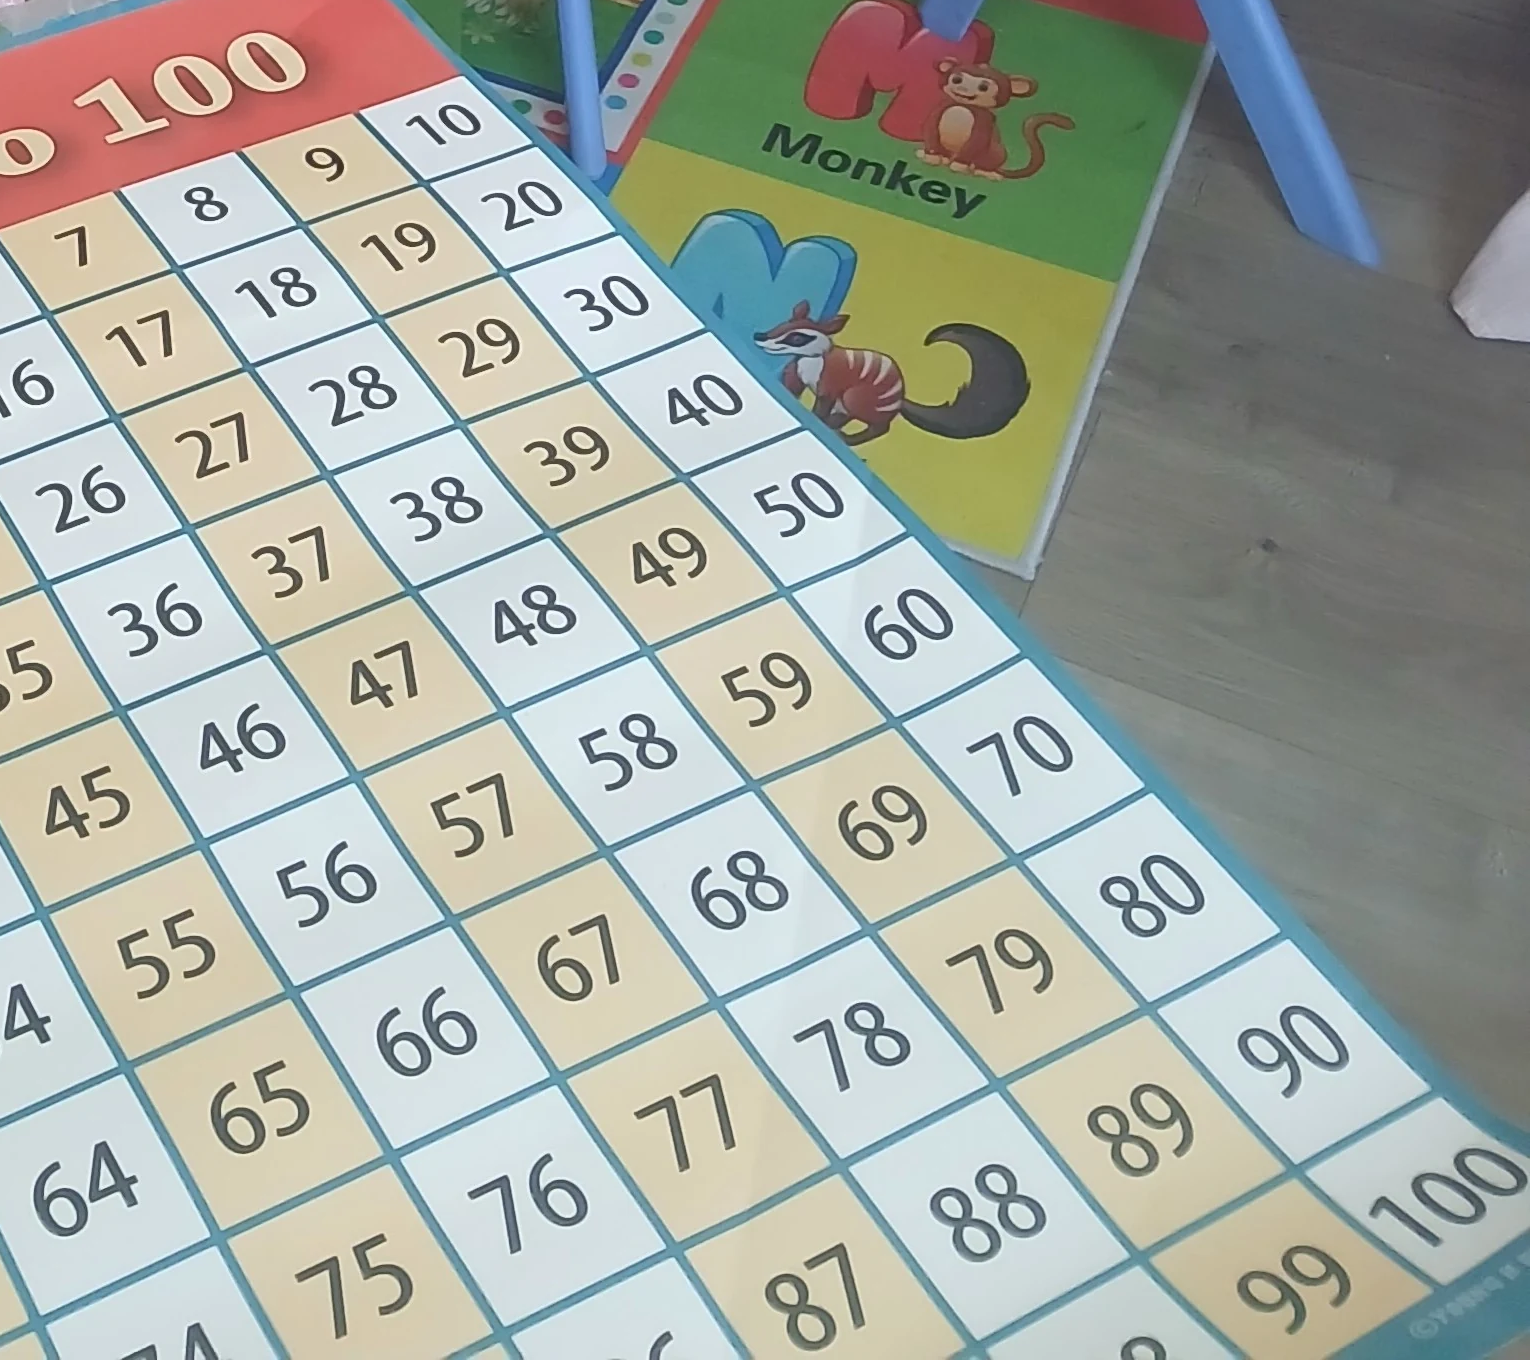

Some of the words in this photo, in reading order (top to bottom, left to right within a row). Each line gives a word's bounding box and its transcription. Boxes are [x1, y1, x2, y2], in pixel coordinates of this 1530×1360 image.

[53, 224, 91, 270] 7
[183, 185, 232, 225] 8
[304, 146, 348, 185] 9
[404, 103, 484, 148] 10
[72, 26, 309, 155] 100
[761, 123, 988, 219] Monkey
[106, 582, 206, 660] 36
[250, 524, 333, 602] 37
[388, 475, 486, 545] 38
[522, 425, 613, 490] 39
[666, 373, 746, 430] 40
[116, 907, 219, 1003] 55
[275, 840, 380, 931] 56
[429, 772, 517, 861] 57
[577, 712, 681, 795] 58
[720, 651, 815, 731] 59
[863, 587, 957, 663] 60
[764, 1241, 868, 1353] 87
[929, 1163, 1050, 1266] 88
[1086, 1082, 1197, 1180] 89
[1236, 1004, 1354, 1101] 90
[1236, 1244, 1354, 1338] 99
[1368, 1146, 1530, 1250] 100
